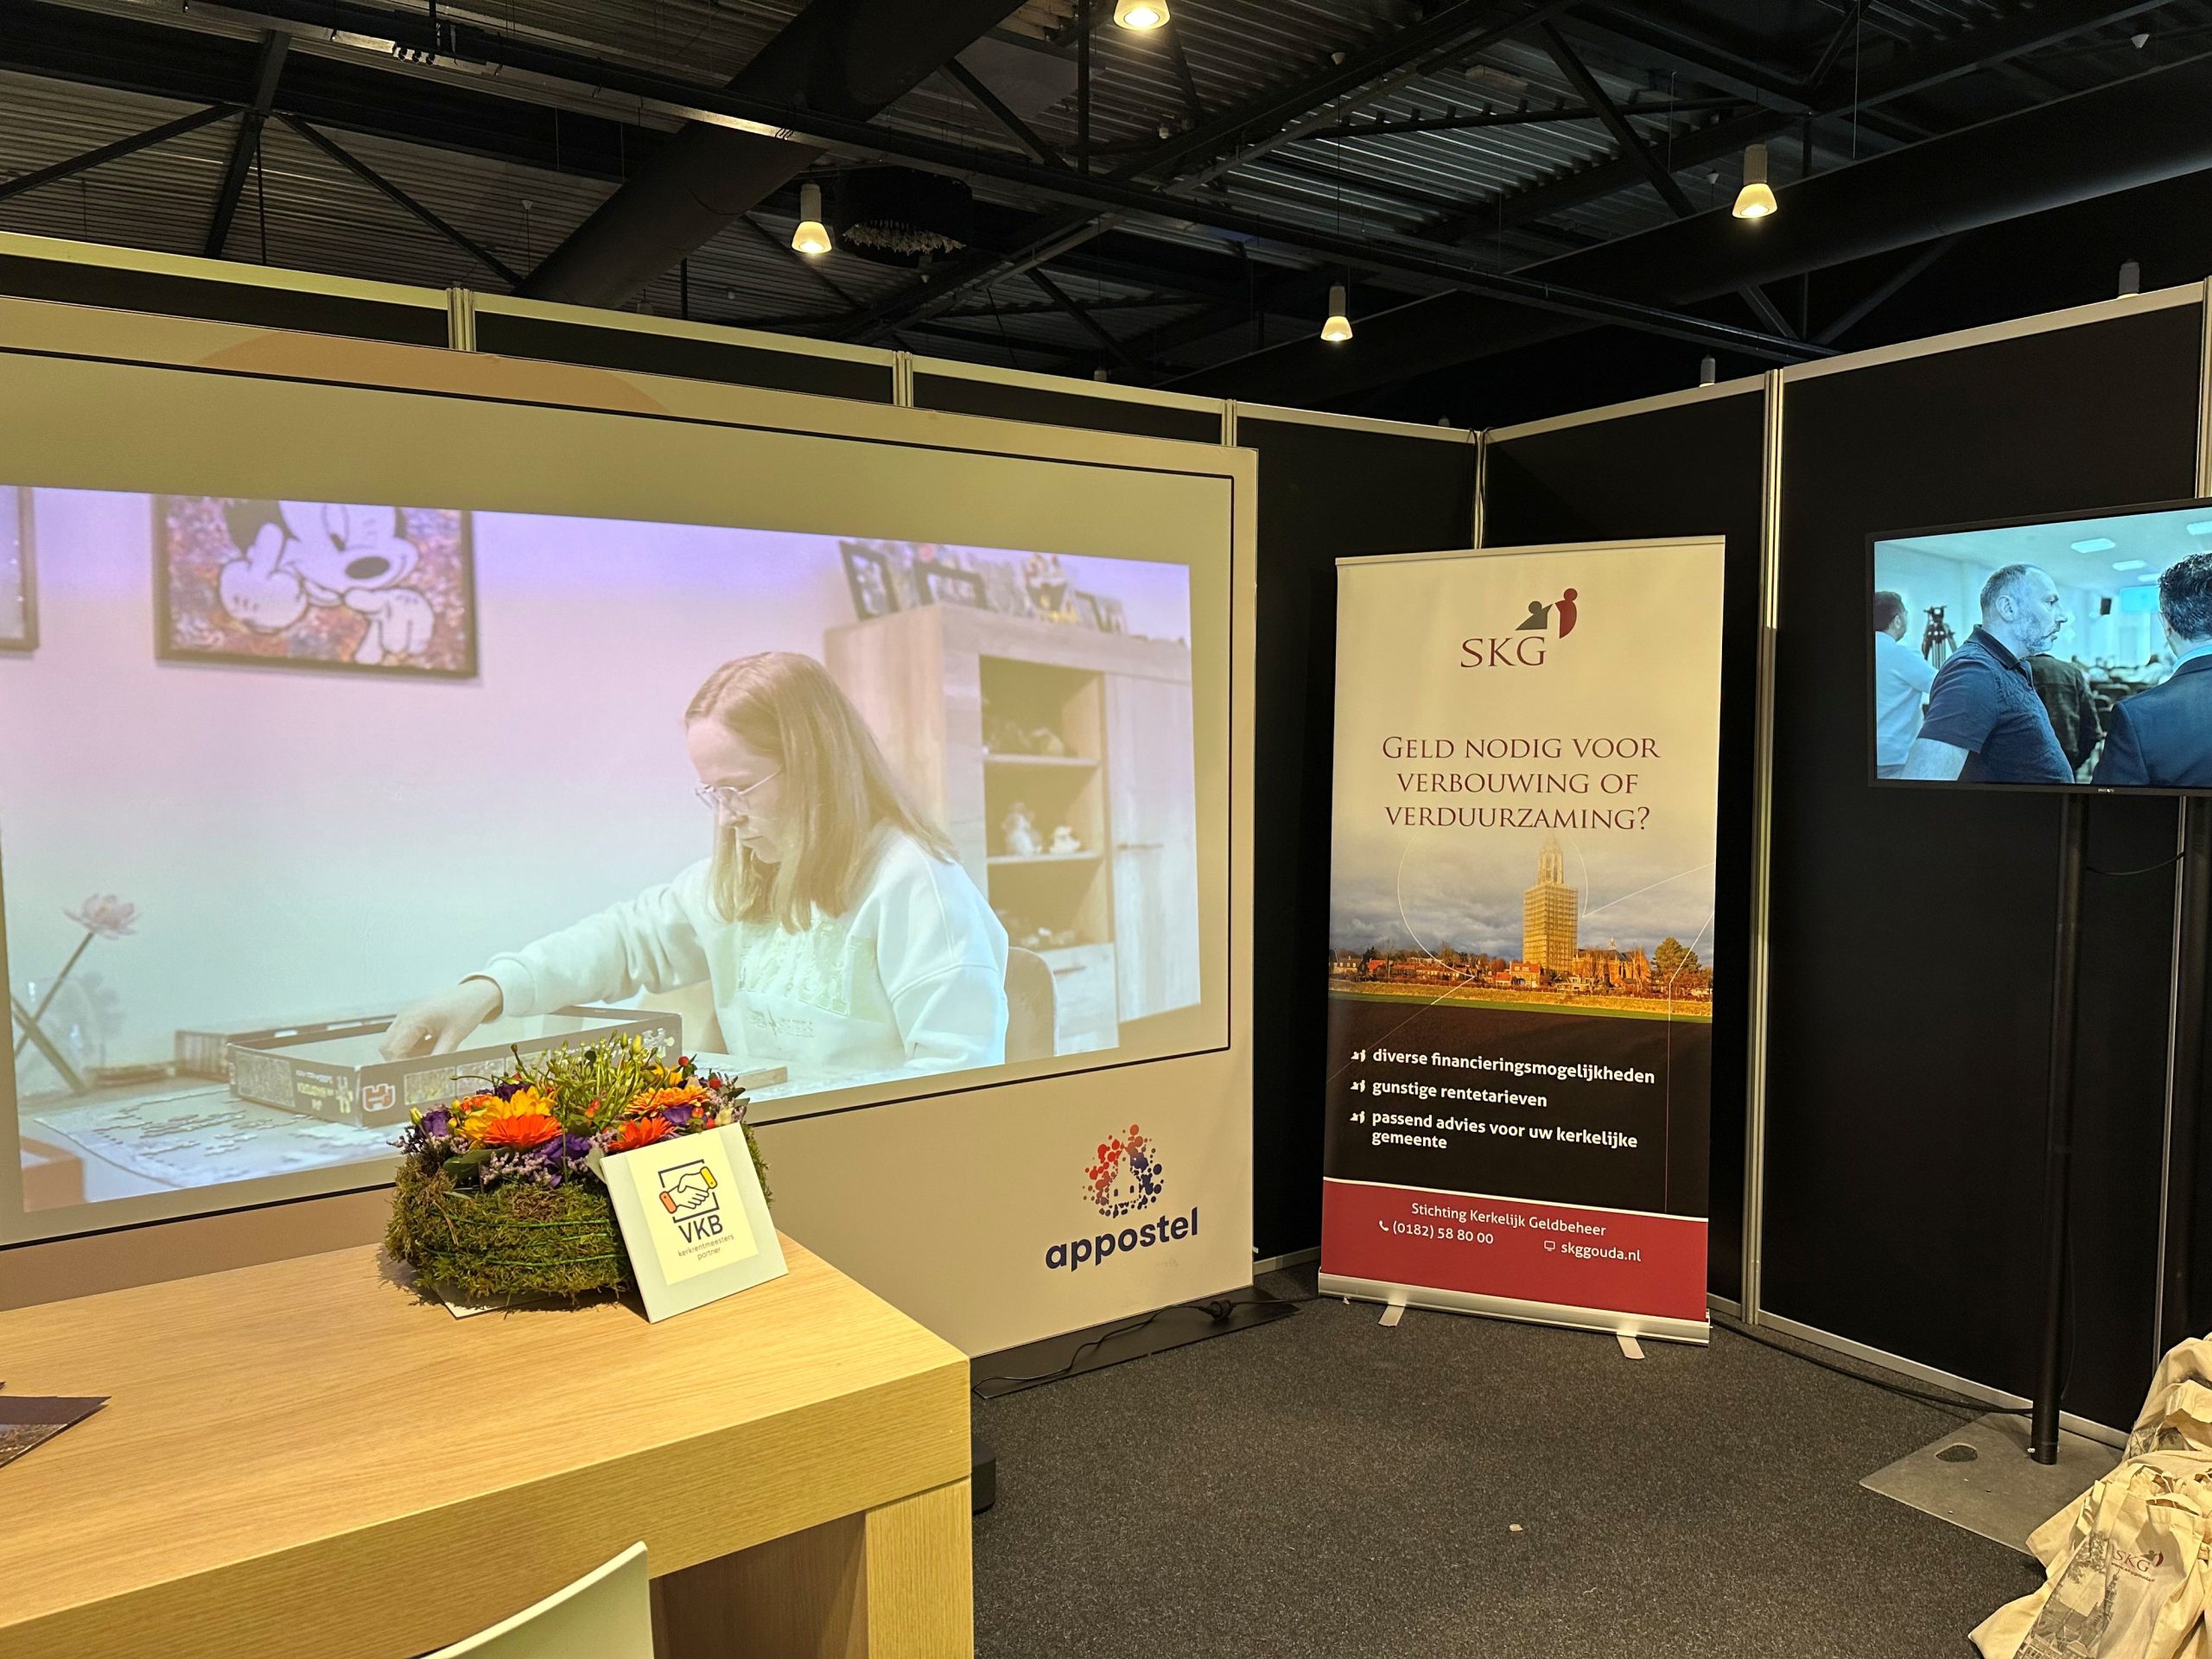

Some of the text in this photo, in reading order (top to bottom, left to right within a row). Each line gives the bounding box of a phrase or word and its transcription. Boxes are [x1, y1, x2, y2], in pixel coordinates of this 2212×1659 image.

[1460, 636, 1547, 668] SKG
[1600, 772, 1640, 795] OF
[1384, 804, 1651, 830] VERDUURZAMING?
[1372, 1048, 1655, 1084] diverse financieringsmogelijkheden
[1371, 1079, 1548, 1108] gunstige rentetarieven
[1371, 1110, 1639, 1149] passend advies voor uw kerkelijke
[1371, 1130, 1447, 1150] gemeente
[678, 1214, 723, 1243] VKB
[1411, 1203, 1606, 1236] Stichting Kerkelijk Geldbeheer
[677, 1234, 734, 1256] kerkrentmeesters
[1045, 1206, 1198, 1272] appostel
[1392, 1221, 1494, 1245] (0182) 58 80 00
[696, 1247, 721, 1260] partner
[1560, 1242, 1641, 1262] skggouda.nl
[2113, 1549, 2150, 1573] SKG
